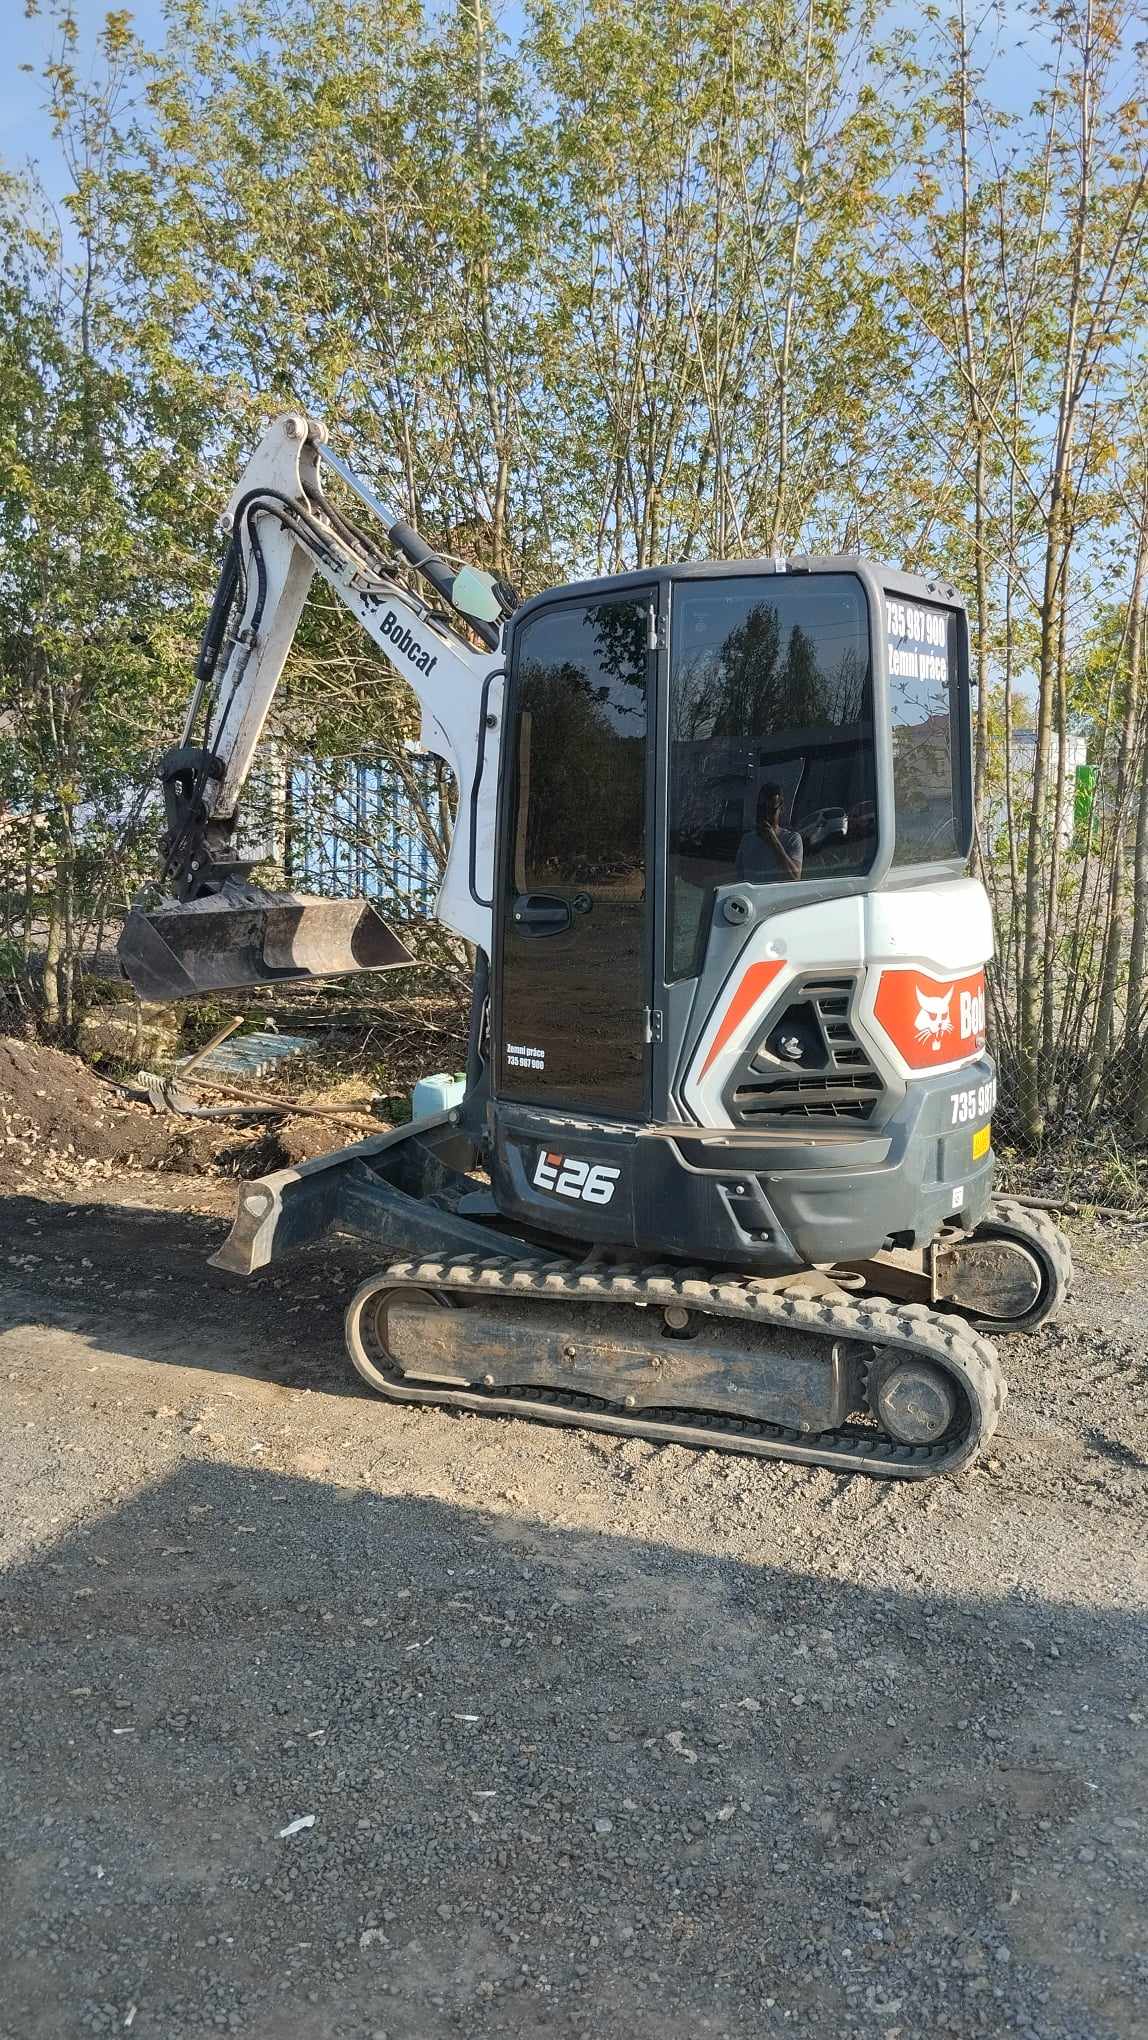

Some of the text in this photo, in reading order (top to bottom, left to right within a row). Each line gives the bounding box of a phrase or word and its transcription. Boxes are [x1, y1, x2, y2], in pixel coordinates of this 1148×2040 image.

[379, 610, 438, 678] Bobcat
[886, 601, 946, 648] 735 987 900
[920, 649, 947, 681] práce
[507, 1056, 544, 1070] 735 987 900
[951, 1089, 976, 1124] 735
[978, 1081, 992, 1116] 987
[533, 1150, 621, 1205] E26
